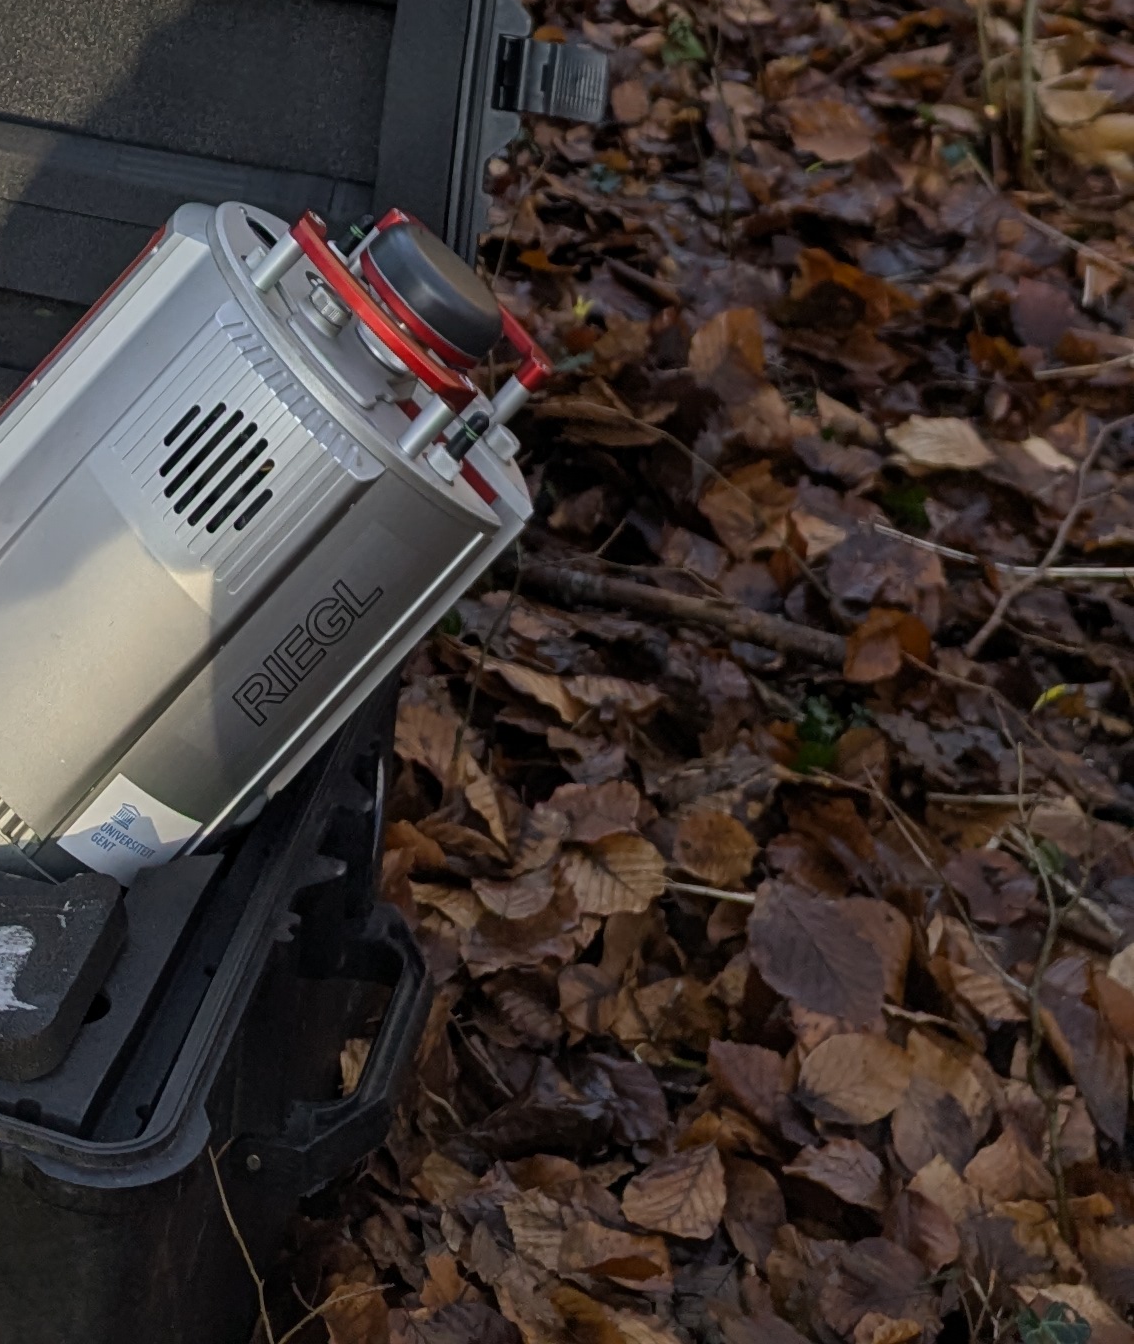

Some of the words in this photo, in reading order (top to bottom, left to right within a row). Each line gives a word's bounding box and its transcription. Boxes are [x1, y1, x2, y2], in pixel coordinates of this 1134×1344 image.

[232, 579, 384, 727] RIEGL
[90, 832, 116, 852] GENT
[100, 822, 156, 859] UNIVERSITEIT
